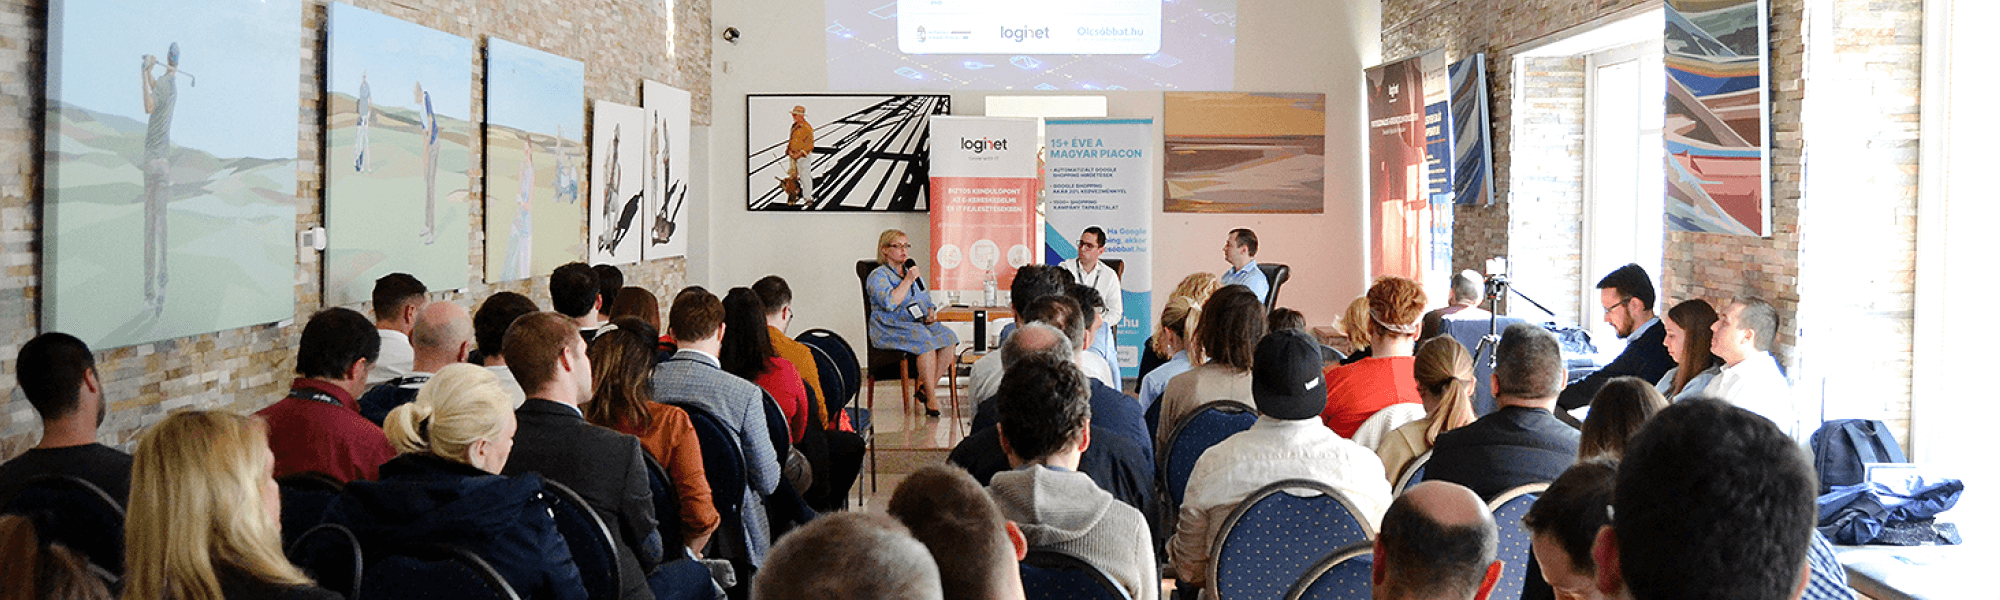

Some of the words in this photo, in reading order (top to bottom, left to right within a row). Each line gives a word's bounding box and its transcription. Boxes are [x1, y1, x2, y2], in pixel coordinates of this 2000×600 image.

[1000, 25, 1050, 42] loginet
[961, 136, 1008, 153] loginet
[1050, 138, 1069, 148] 15+
[1071, 136, 1093, 148] ÉVE
[1095, 138, 1104, 148] A
[1050, 149, 1098, 158] MAGYAR
[1100, 149, 1142, 158] PIACON
[1119, 228, 1147, 236] Google
